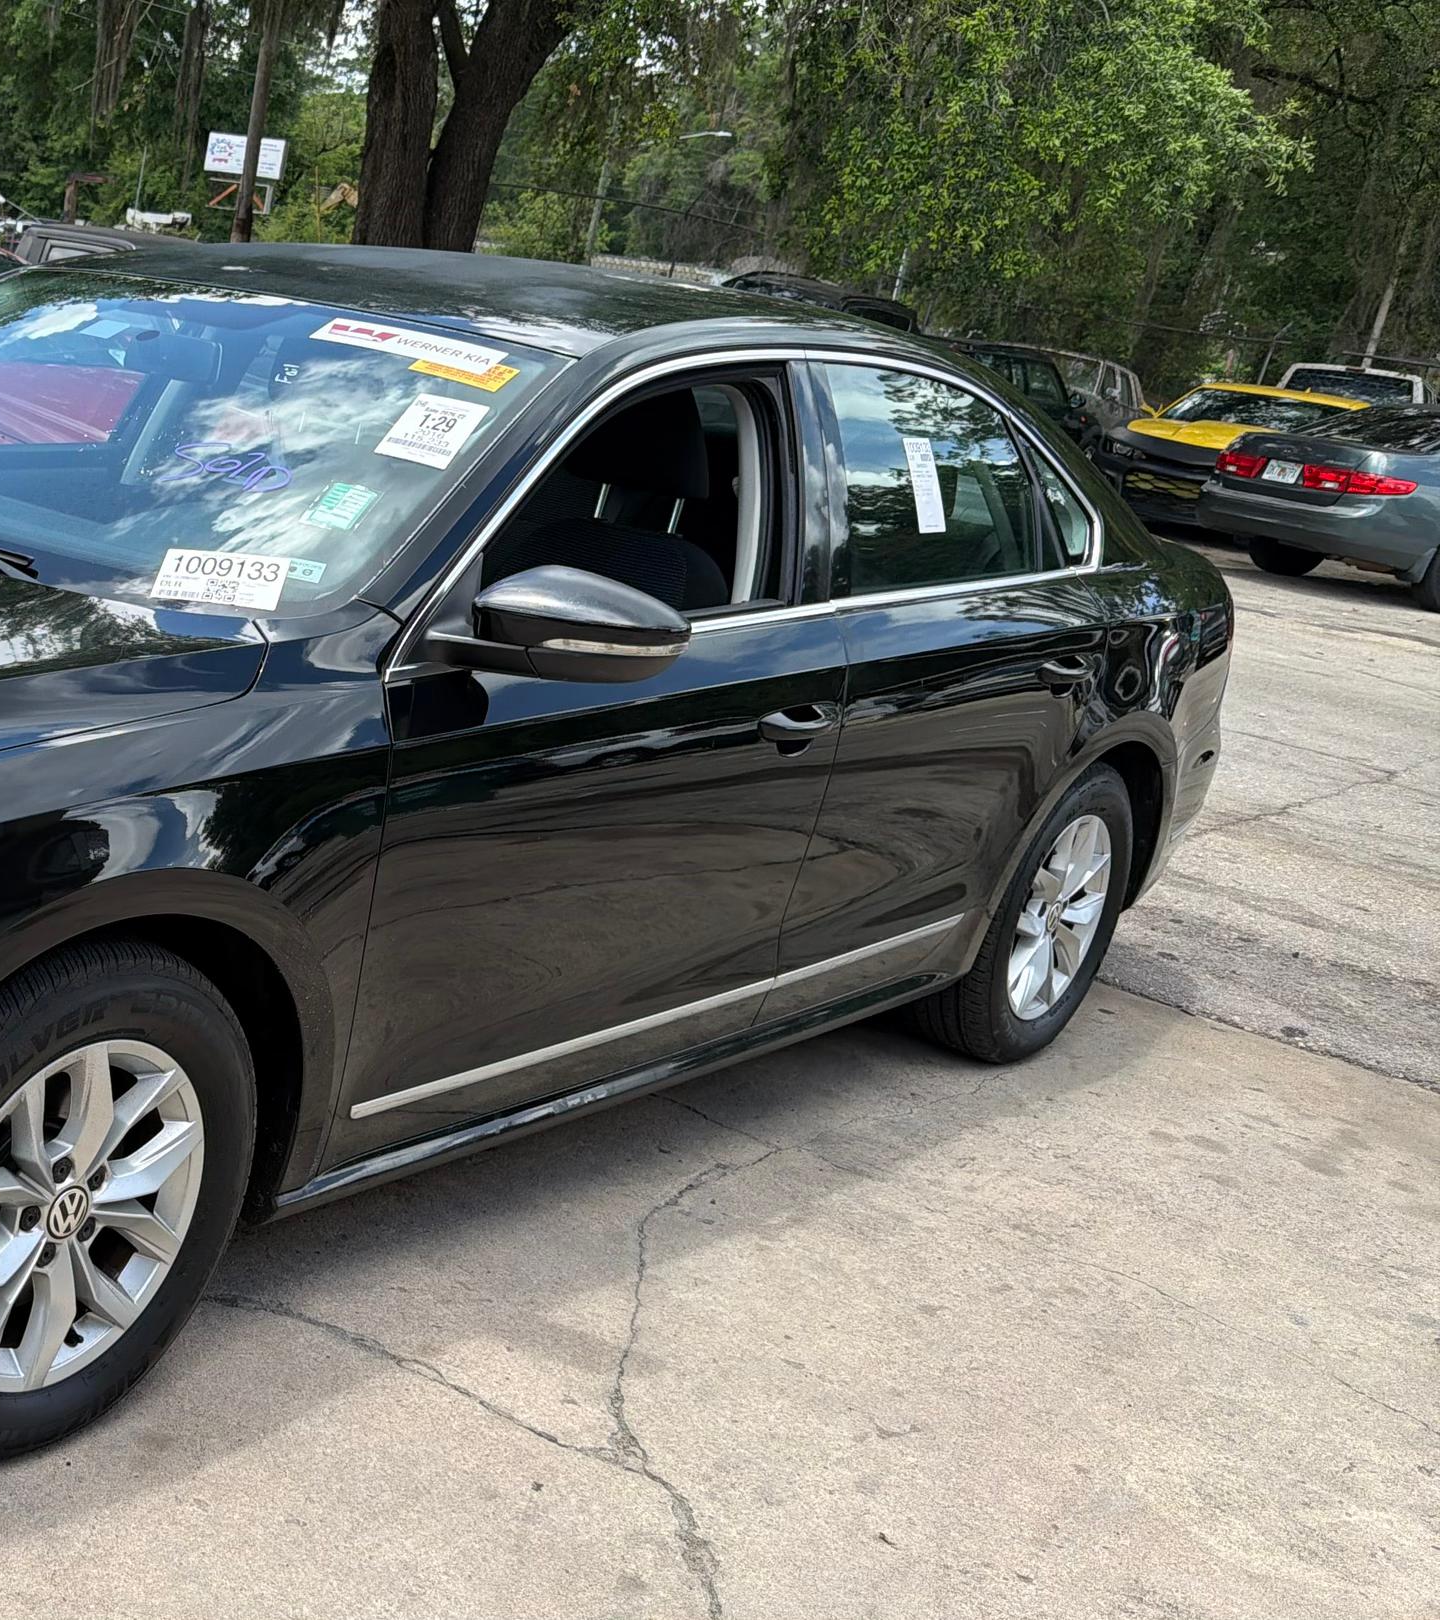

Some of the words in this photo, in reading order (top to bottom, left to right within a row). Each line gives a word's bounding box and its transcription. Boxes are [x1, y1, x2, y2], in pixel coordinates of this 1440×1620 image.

[397, 337, 462, 357] WERNER
[463, 353, 491, 366] KIA
[419, 413, 458, 433] 1:29
[173, 554, 281, 582] 1009133
